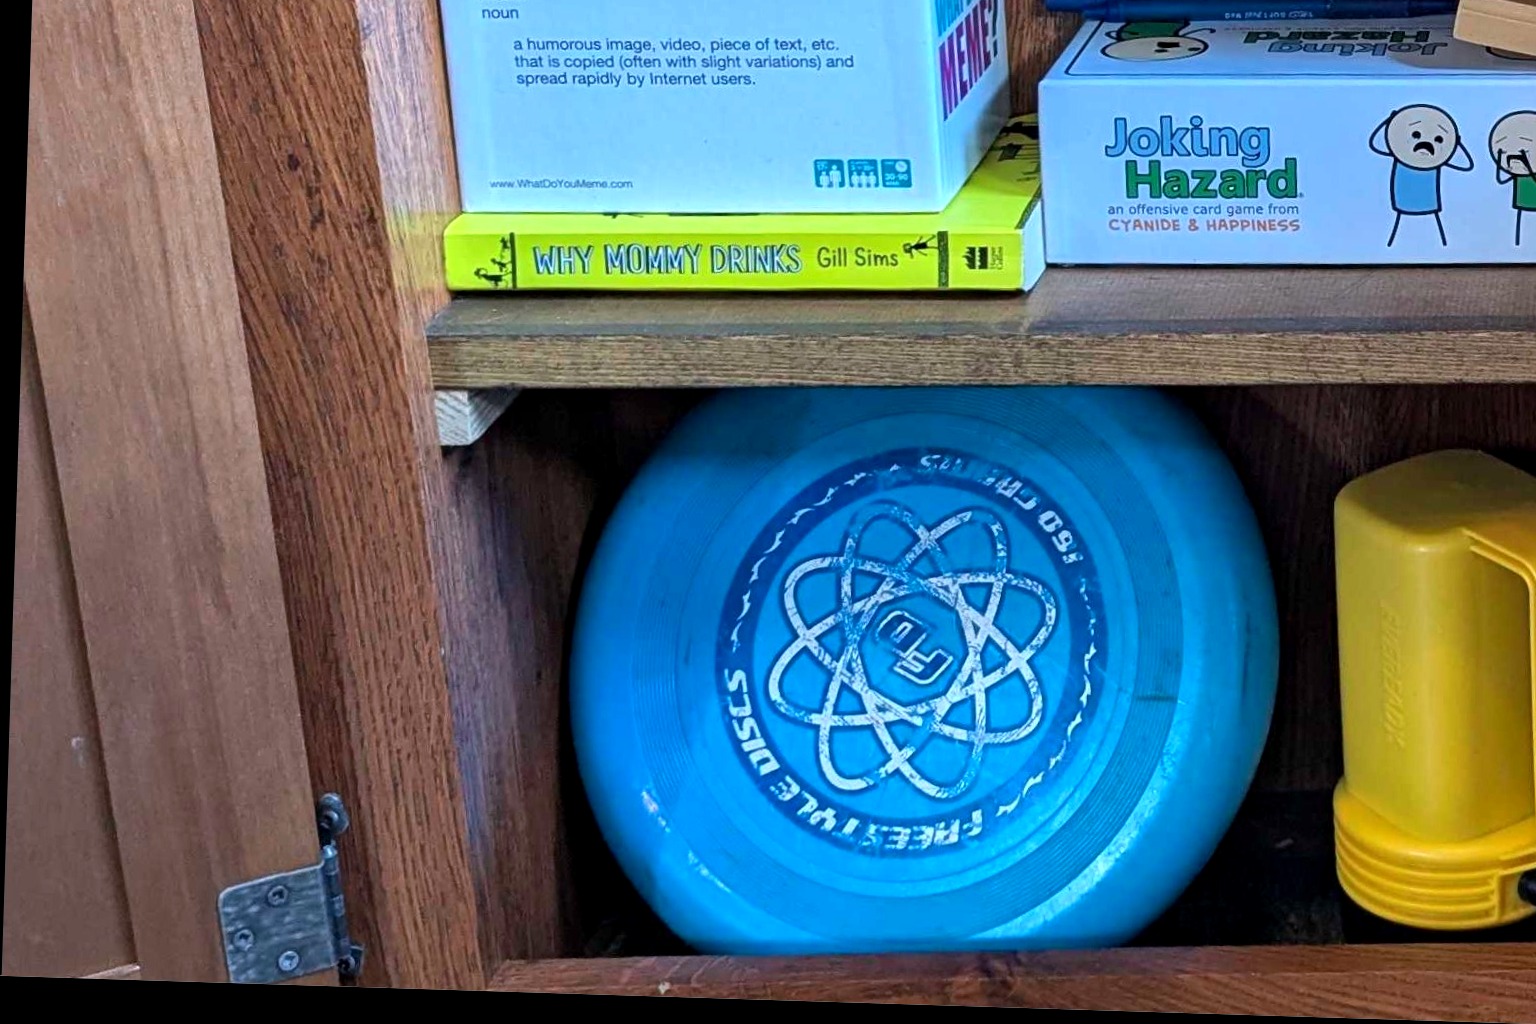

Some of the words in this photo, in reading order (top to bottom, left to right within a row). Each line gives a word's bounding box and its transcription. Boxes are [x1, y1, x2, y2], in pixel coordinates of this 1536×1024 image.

[482, 8, 519, 19] noun
[527, 38, 601, 51] humorous
[606, 38, 656, 53] image,
[660, 38, 706, 52] video,
[711, 38, 750, 53] piece
[755, 38, 770, 51] of
[775, 39, 807, 52] text,
[811, 39, 840, 51] etc.
[1268, 41, 1448, 57] Joking
[514, 56, 544, 68] that
[548, 55, 560, 67] is
[564, 55, 615, 71] copied
[619, 55, 661, 71] (often
[665, 55, 696, 68] with
[702, 55, 741, 71] slight
[745, 55, 822, 71] variations)
[826, 55, 854, 68] and
[517, 72, 568, 87] spread
[572, 72, 622, 87] rapidly
[627, 72, 645, 88] by
[650, 72, 707, 85] Internet
[711, 75, 756, 86] users.
[1105, 115, 1271, 167] Joking
[489, 178, 634, 190] www.WhatDoYouMeme.com
[1125, 157, 1298, 199] Hazard
[1108, 205, 1123, 215] an
[1129, 204, 1188, 214] offensive
[1193, 204, 1221, 214] card
[1227, 205, 1263, 216] game
[1268, 204, 1299, 214] from
[1109, 219, 1180, 232] CYANIDE
[1207, 219, 1300, 231] HAPPINESS
[533, 244, 594, 275] WHY
[604, 244, 701, 274] MOMMY
[711, 244, 802, 274] DRINKS
[817, 246, 847, 267] Gill
[854, 247, 899, 267] Sims
[724, 668, 781, 776] DISCS
[769, 775, 984, 851] FREESTYLE
